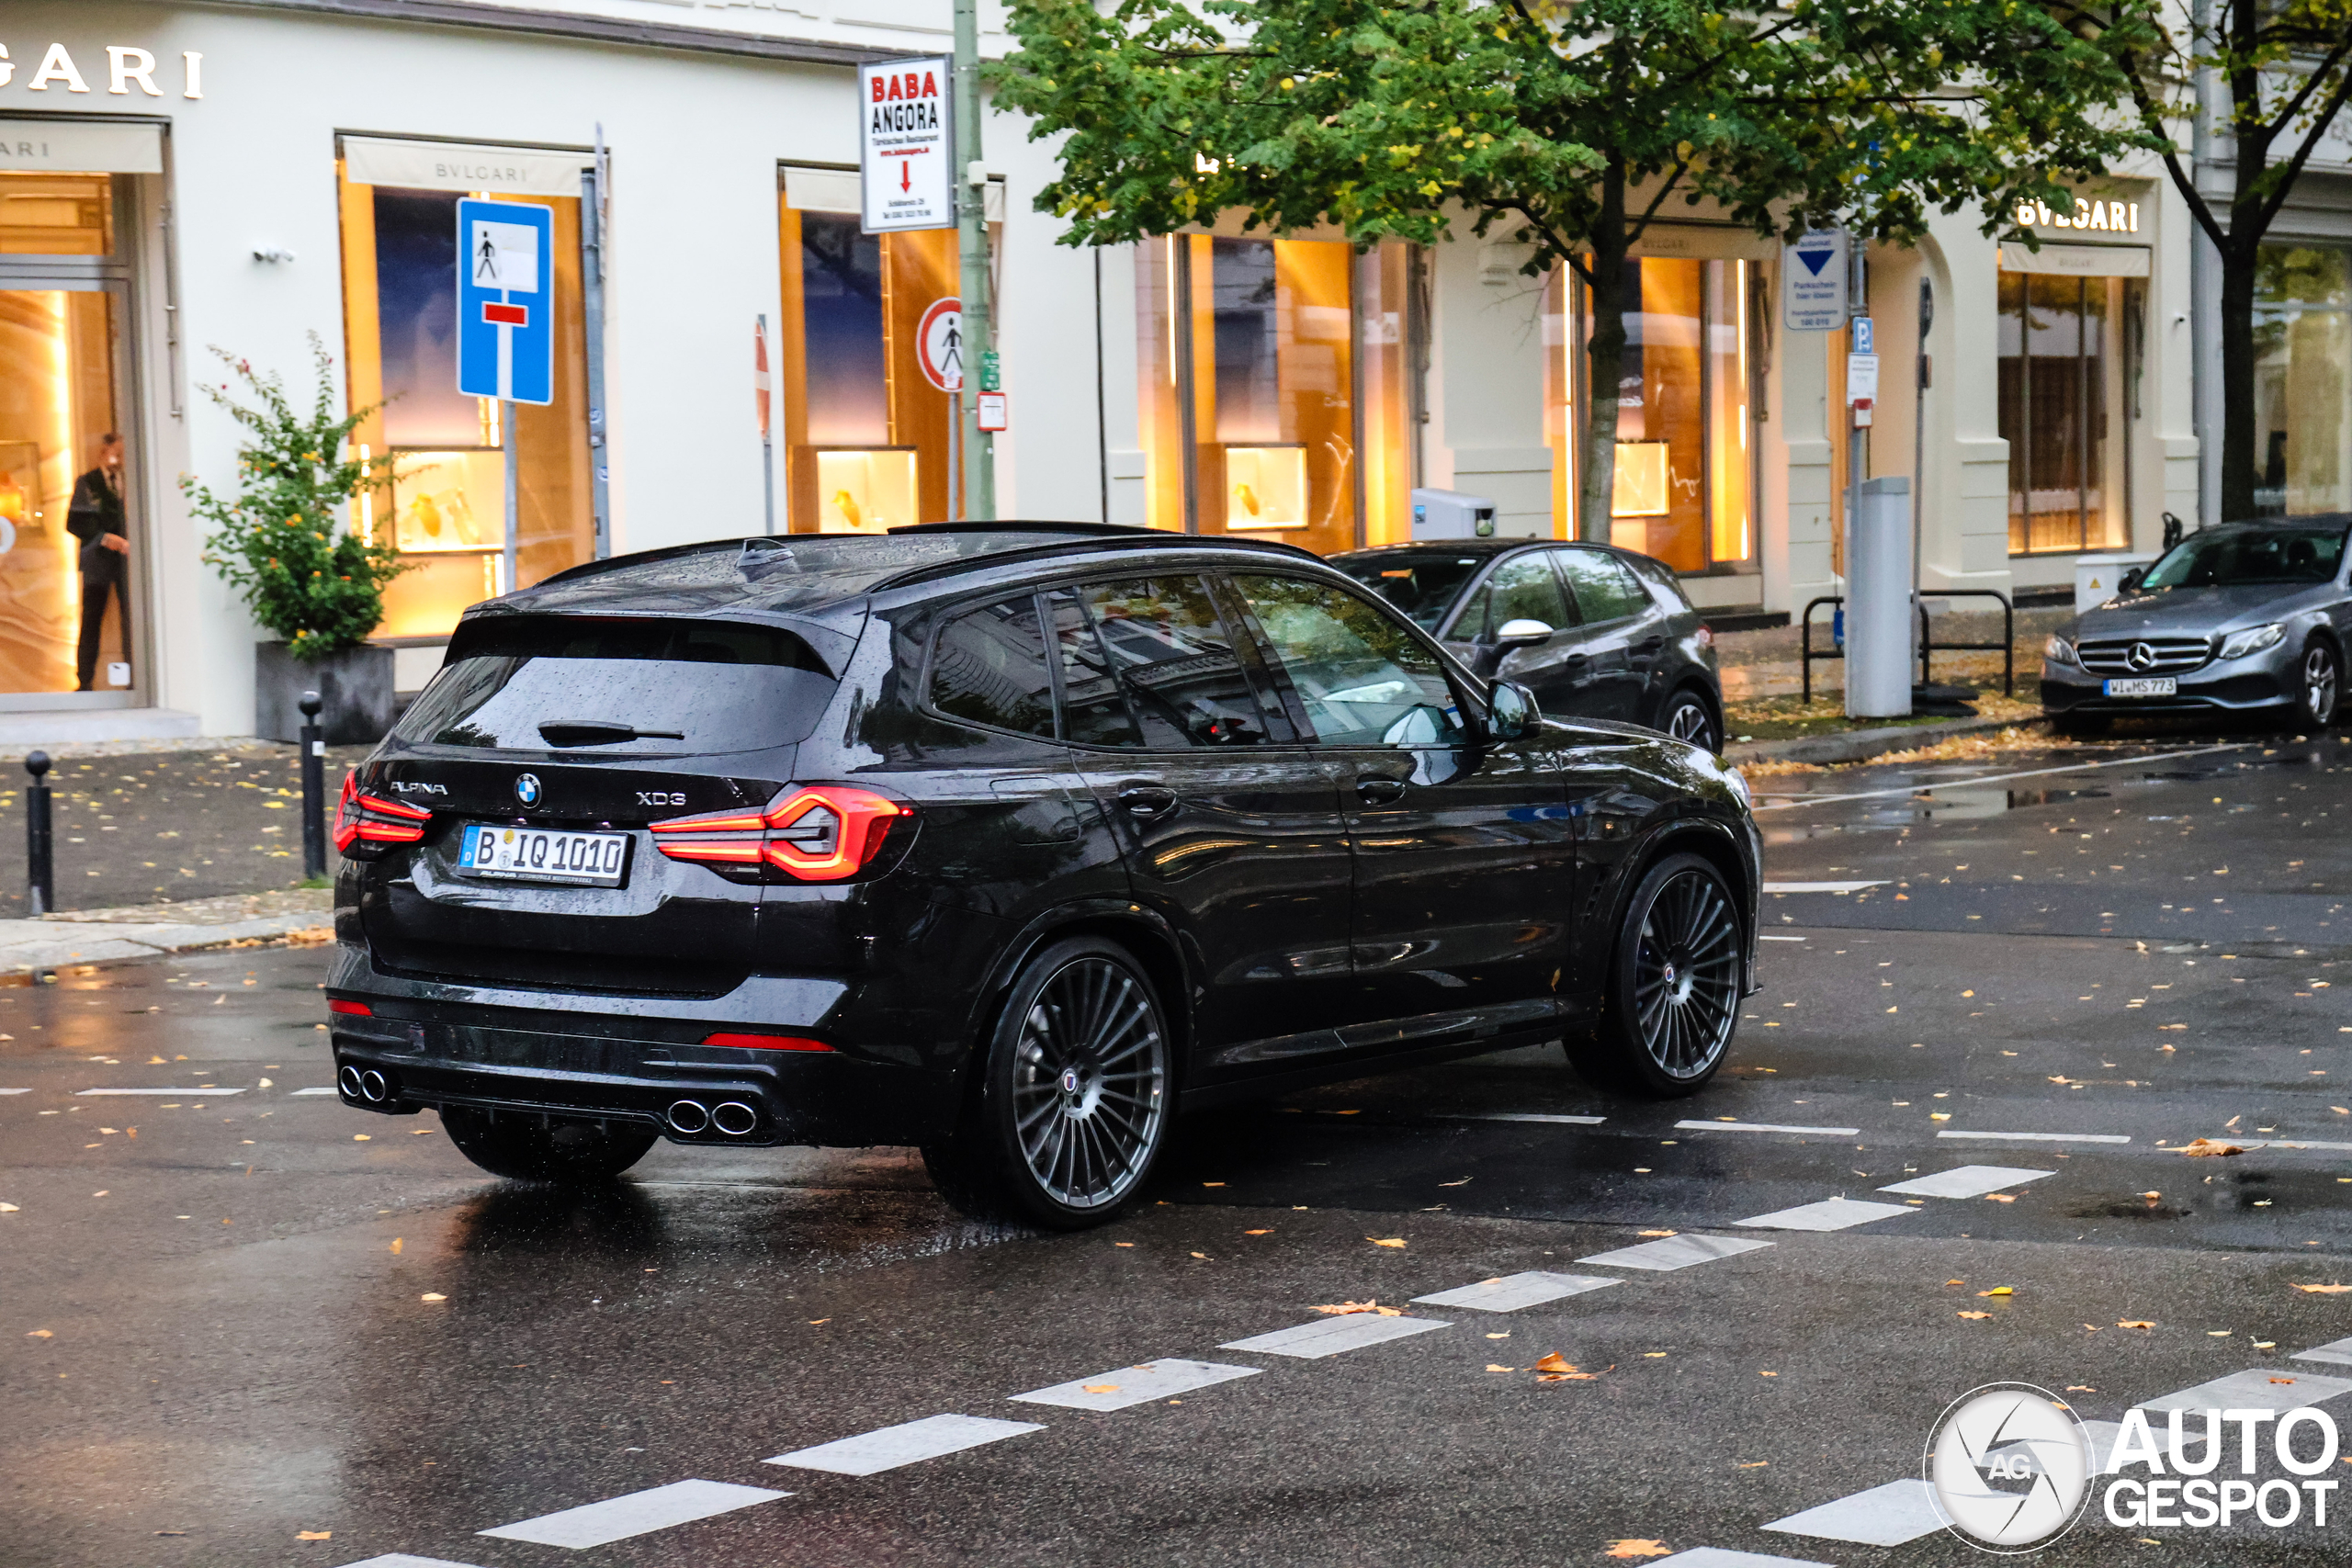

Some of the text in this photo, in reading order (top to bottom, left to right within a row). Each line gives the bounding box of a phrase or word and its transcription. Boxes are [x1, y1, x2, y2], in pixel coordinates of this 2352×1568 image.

[871, 72, 938, 103] BABA
[872, 102, 939, 134] ANGORA
[435, 164, 527, 182] BVLGARI
[1858, 321, 1870, 350] P
[2111, 679, 2174, 693] WI MS 773
[390, 781, 448, 795] ALPINA
[635, 791, 687, 807] XD3
[464, 852, 472, 862] D
[478, 831, 495, 864] B
[514, 834, 548, 868] IQ
[552, 837, 621, 873] 1010
[480, 870, 517, 878] ALPINA
